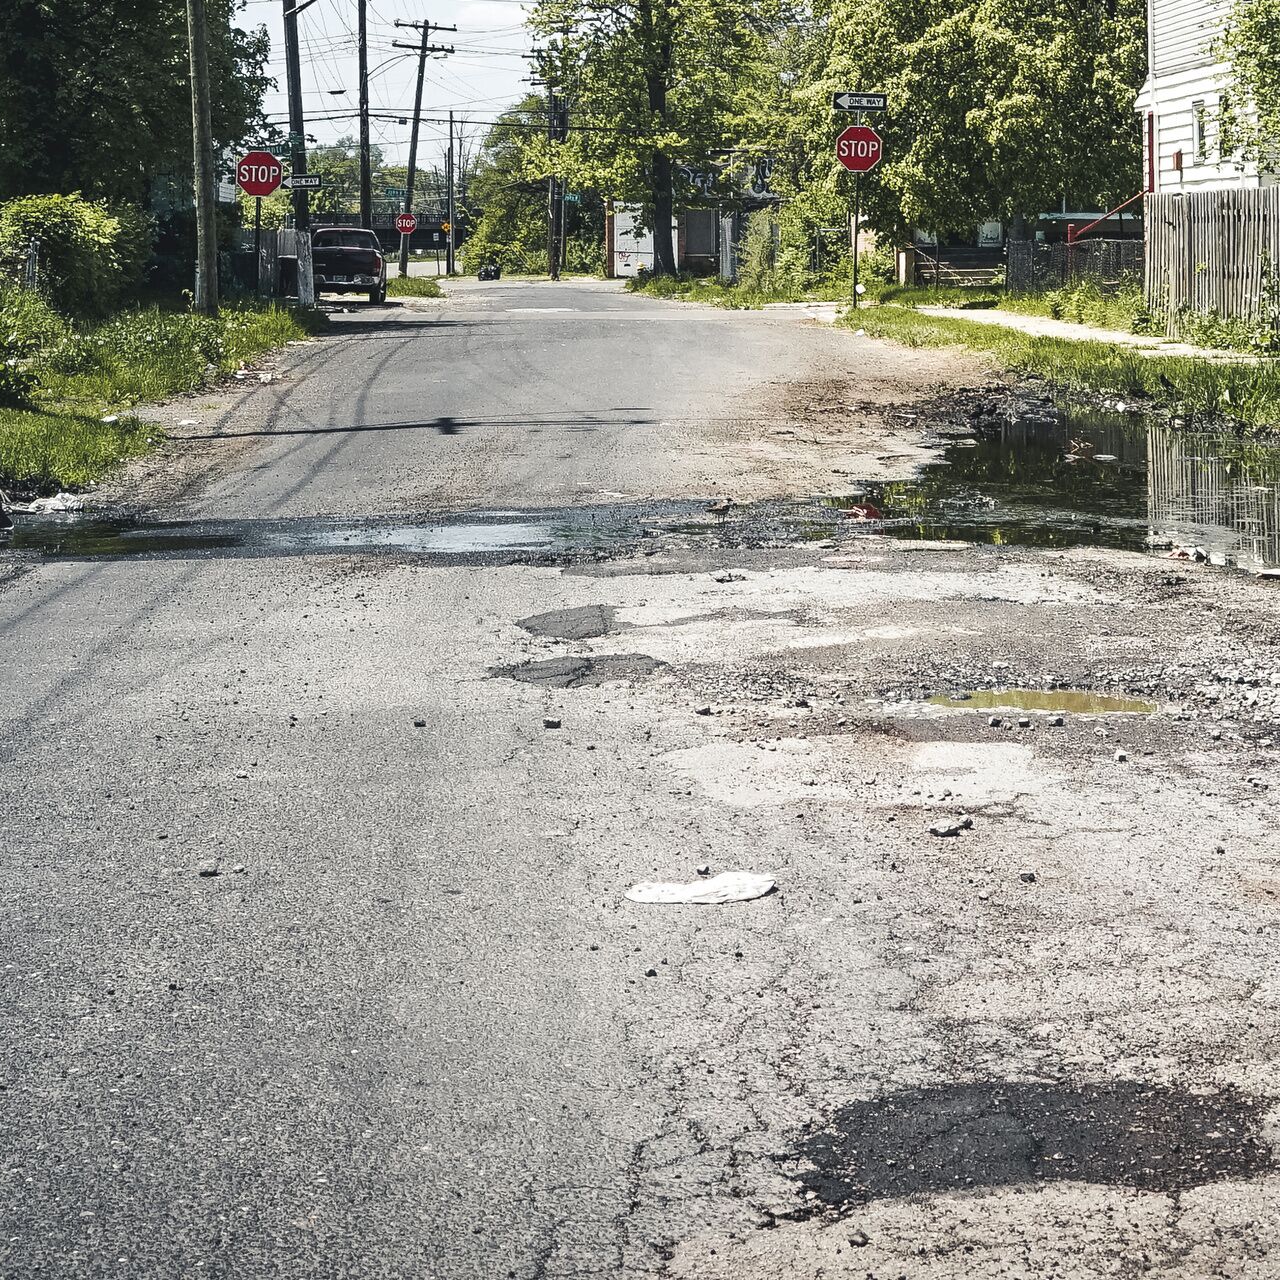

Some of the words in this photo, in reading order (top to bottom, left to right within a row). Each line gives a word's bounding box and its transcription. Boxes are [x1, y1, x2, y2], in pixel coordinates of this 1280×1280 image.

[849, 98, 863, 106] ONE
[866, 98, 882, 106] WAY
[839, 140, 879, 157] STOP
[240, 165, 279, 182] STOP
[397, 219, 416, 228] STOP
